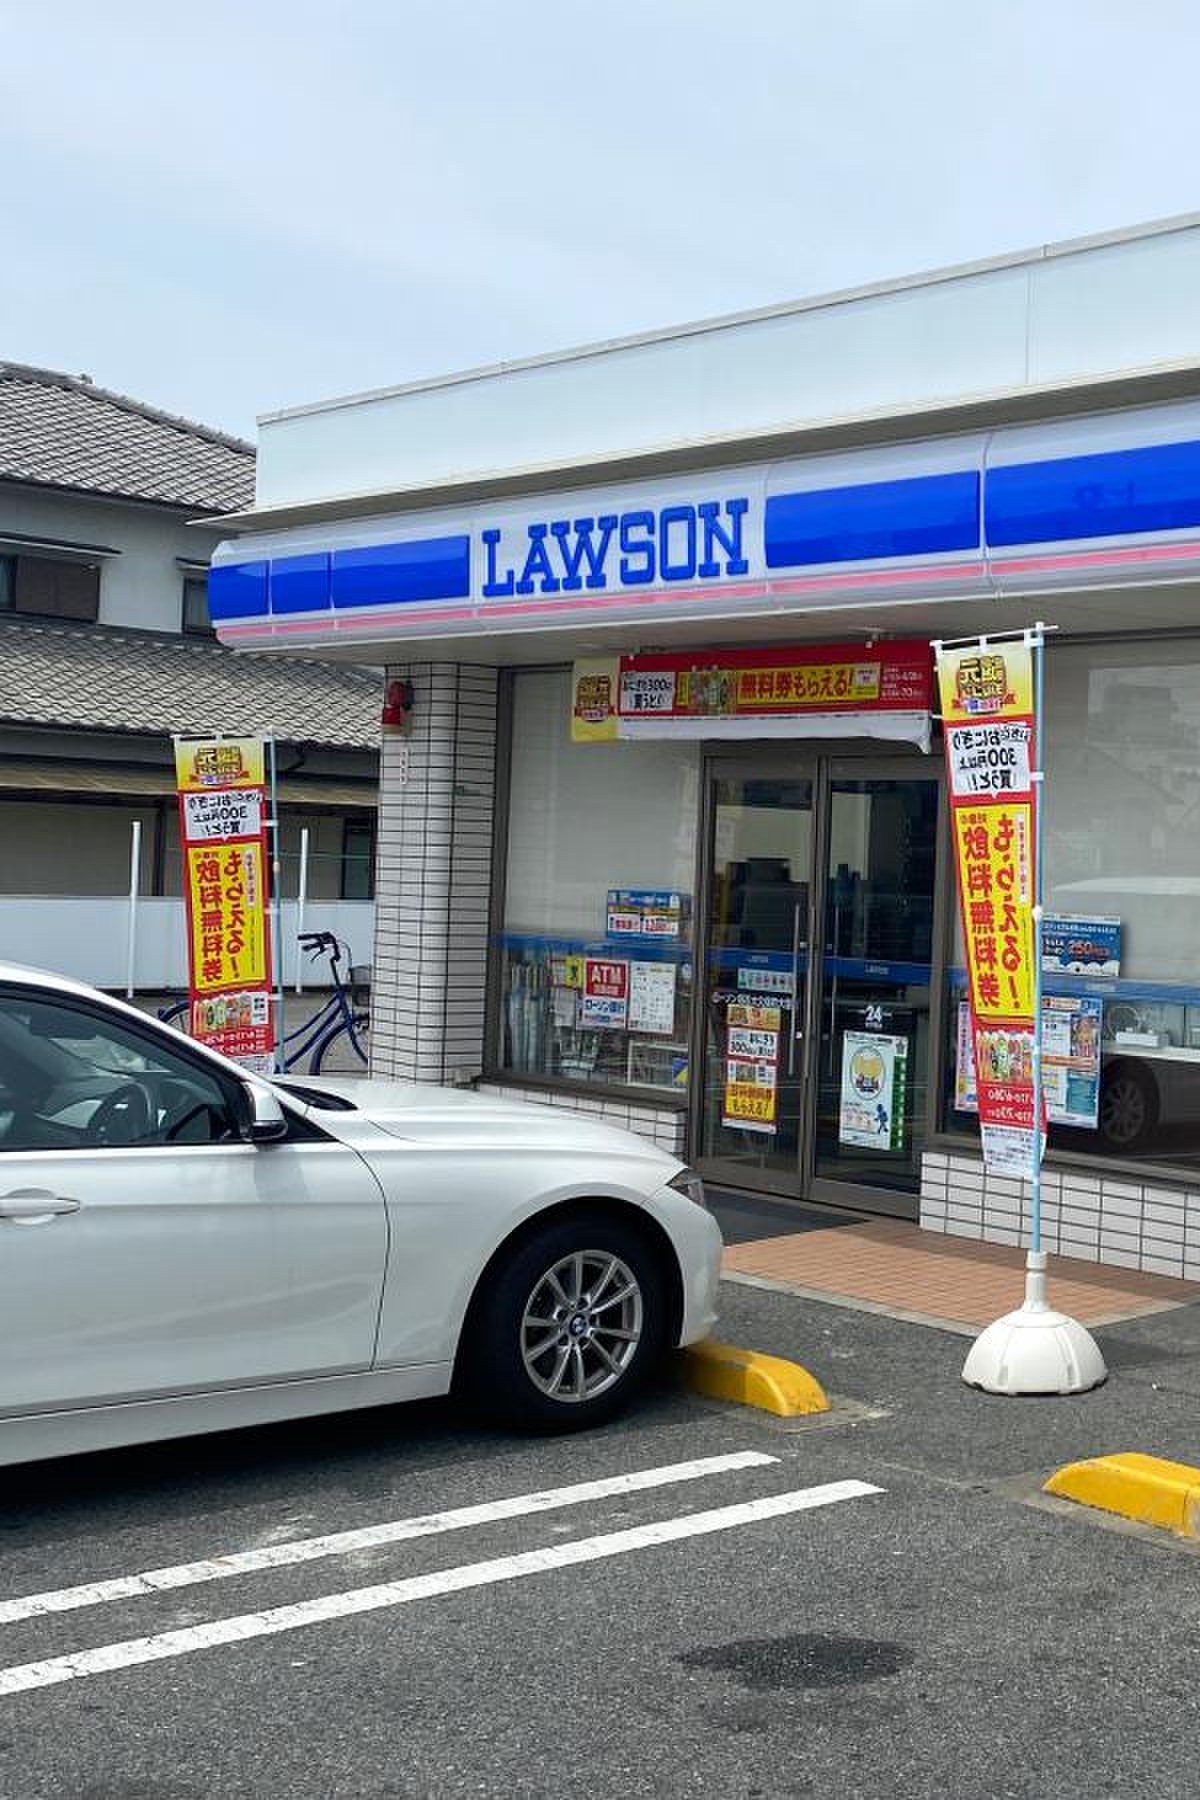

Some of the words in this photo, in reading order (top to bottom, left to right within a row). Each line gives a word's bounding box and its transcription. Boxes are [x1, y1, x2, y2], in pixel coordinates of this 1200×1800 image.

[482, 498, 749, 598] LAWSON
[591, 964, 622, 984] ATM
[865, 1004, 883, 1022] 24
